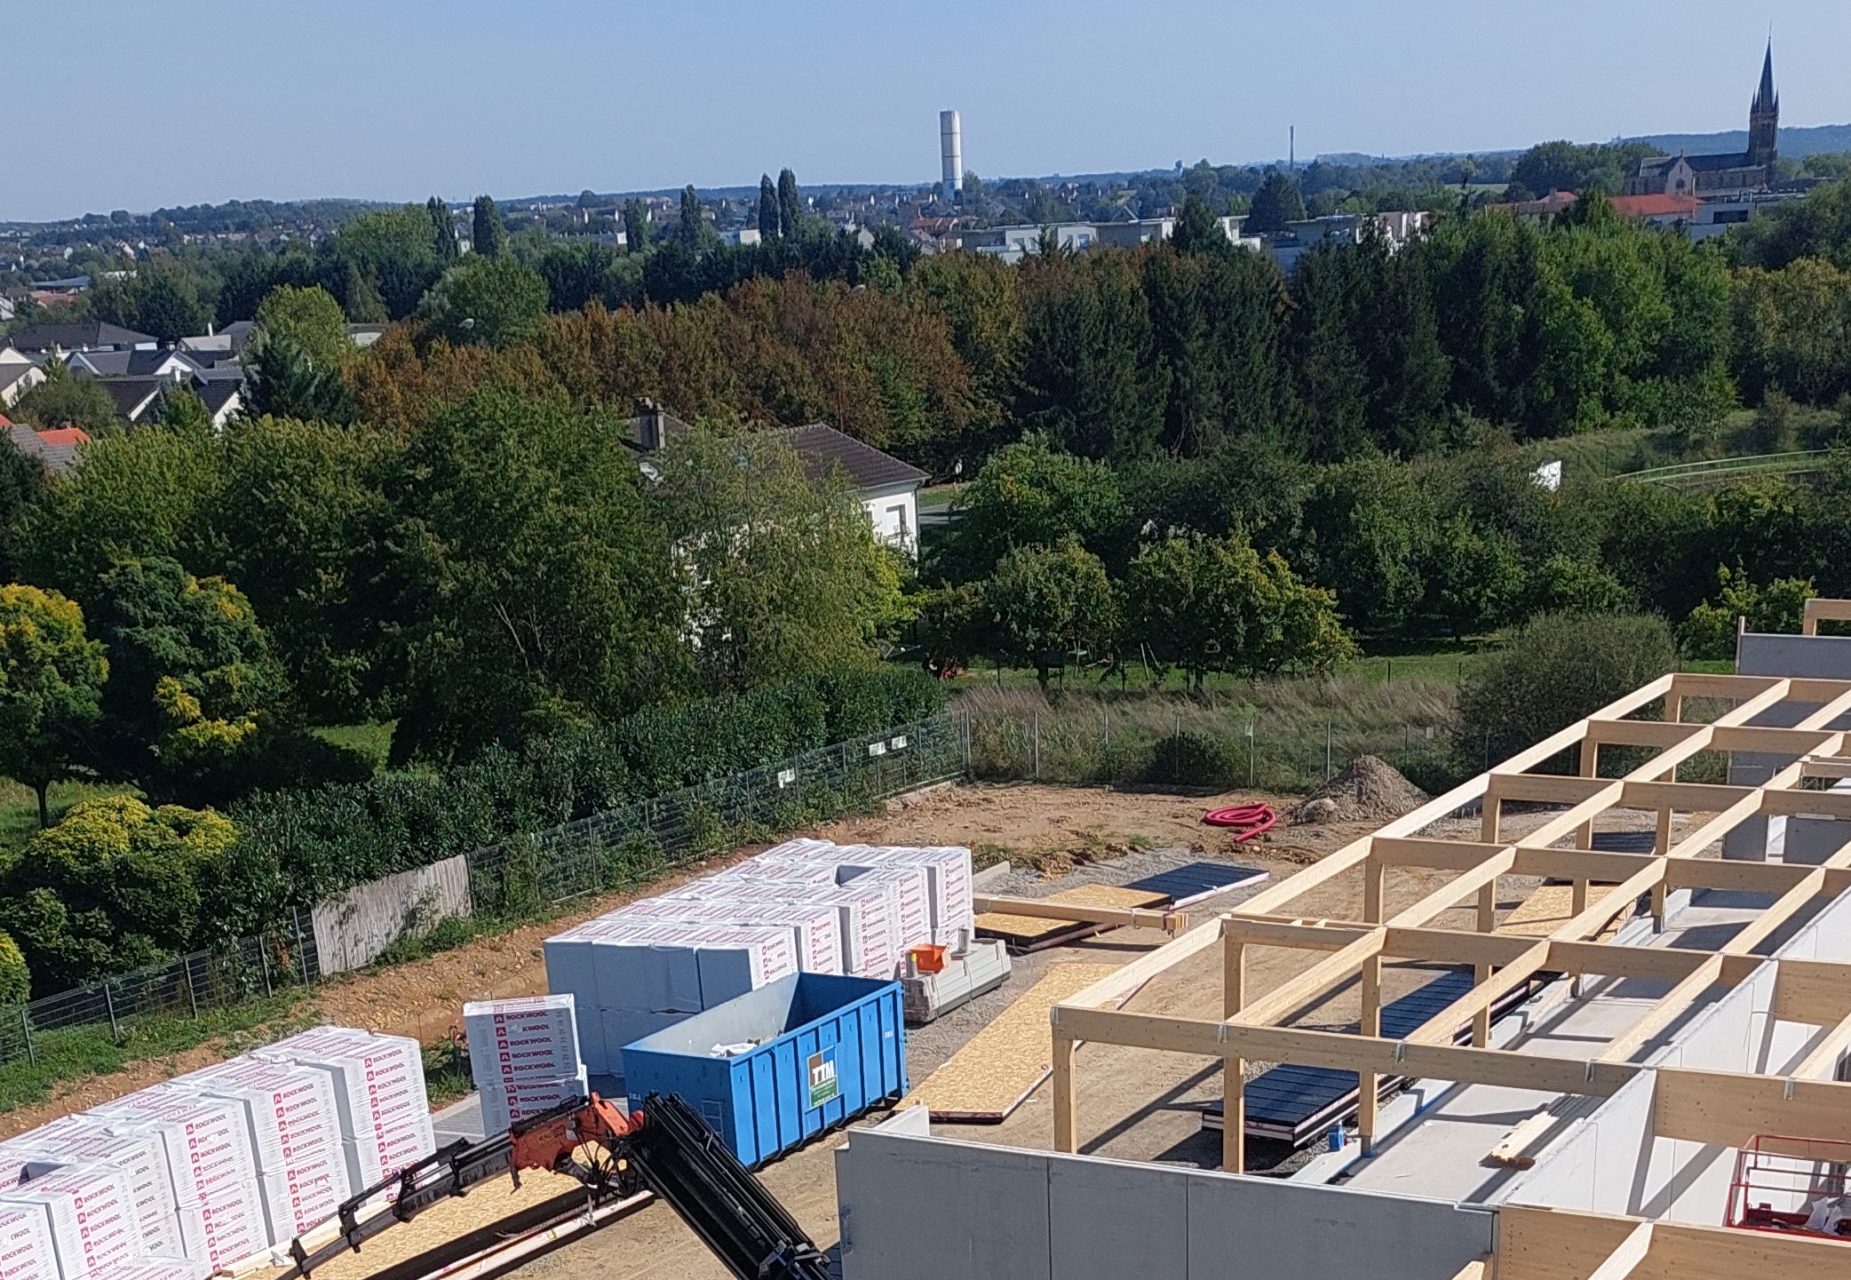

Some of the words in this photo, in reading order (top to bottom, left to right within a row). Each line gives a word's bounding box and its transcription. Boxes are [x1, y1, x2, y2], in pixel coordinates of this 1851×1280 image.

[506, 1010, 548, 1020] ROCKWOOL
[510, 1037, 552, 1046] ROCKWOOL
[512, 1050, 553, 1058] ROCKWOOL
[375, 1062, 404, 1076] ROCKWOOL
[514, 1063, 555, 1071] ROCKWOOL
[812, 1060, 835, 1086] TTM
[283, 1082, 314, 1099] ROCKWOOL
[286, 1097, 317, 1112] ROCKWOOL
[520, 1095, 561, 1103] ROCKWOOL
[195, 1113, 227, 1130] ROCKWOOL
[293, 1136, 325, 1153] ROCKWOOL
[387, 1133, 416, 1148] ROCKWOOL
[200, 1142, 232, 1158] ROCKWOOL
[297, 1160, 328, 1176] ROCKWOOL
[84, 1184, 116, 1203] ROCKWOOL
[87, 1199, 118, 1218] ROCKWOOL
[212, 1198, 243, 1215] ROCKWOOL
[304, 1199, 335, 1215] ROCKWOOL
[90, 1213, 122, 1232] ROCKWOOL
[2, 1242, 34, 1261] ROCKWOOL
[219, 1238, 250, 1256] ROCKWOOL
[4, 1258, 37, 1277] ROCKWOOL
